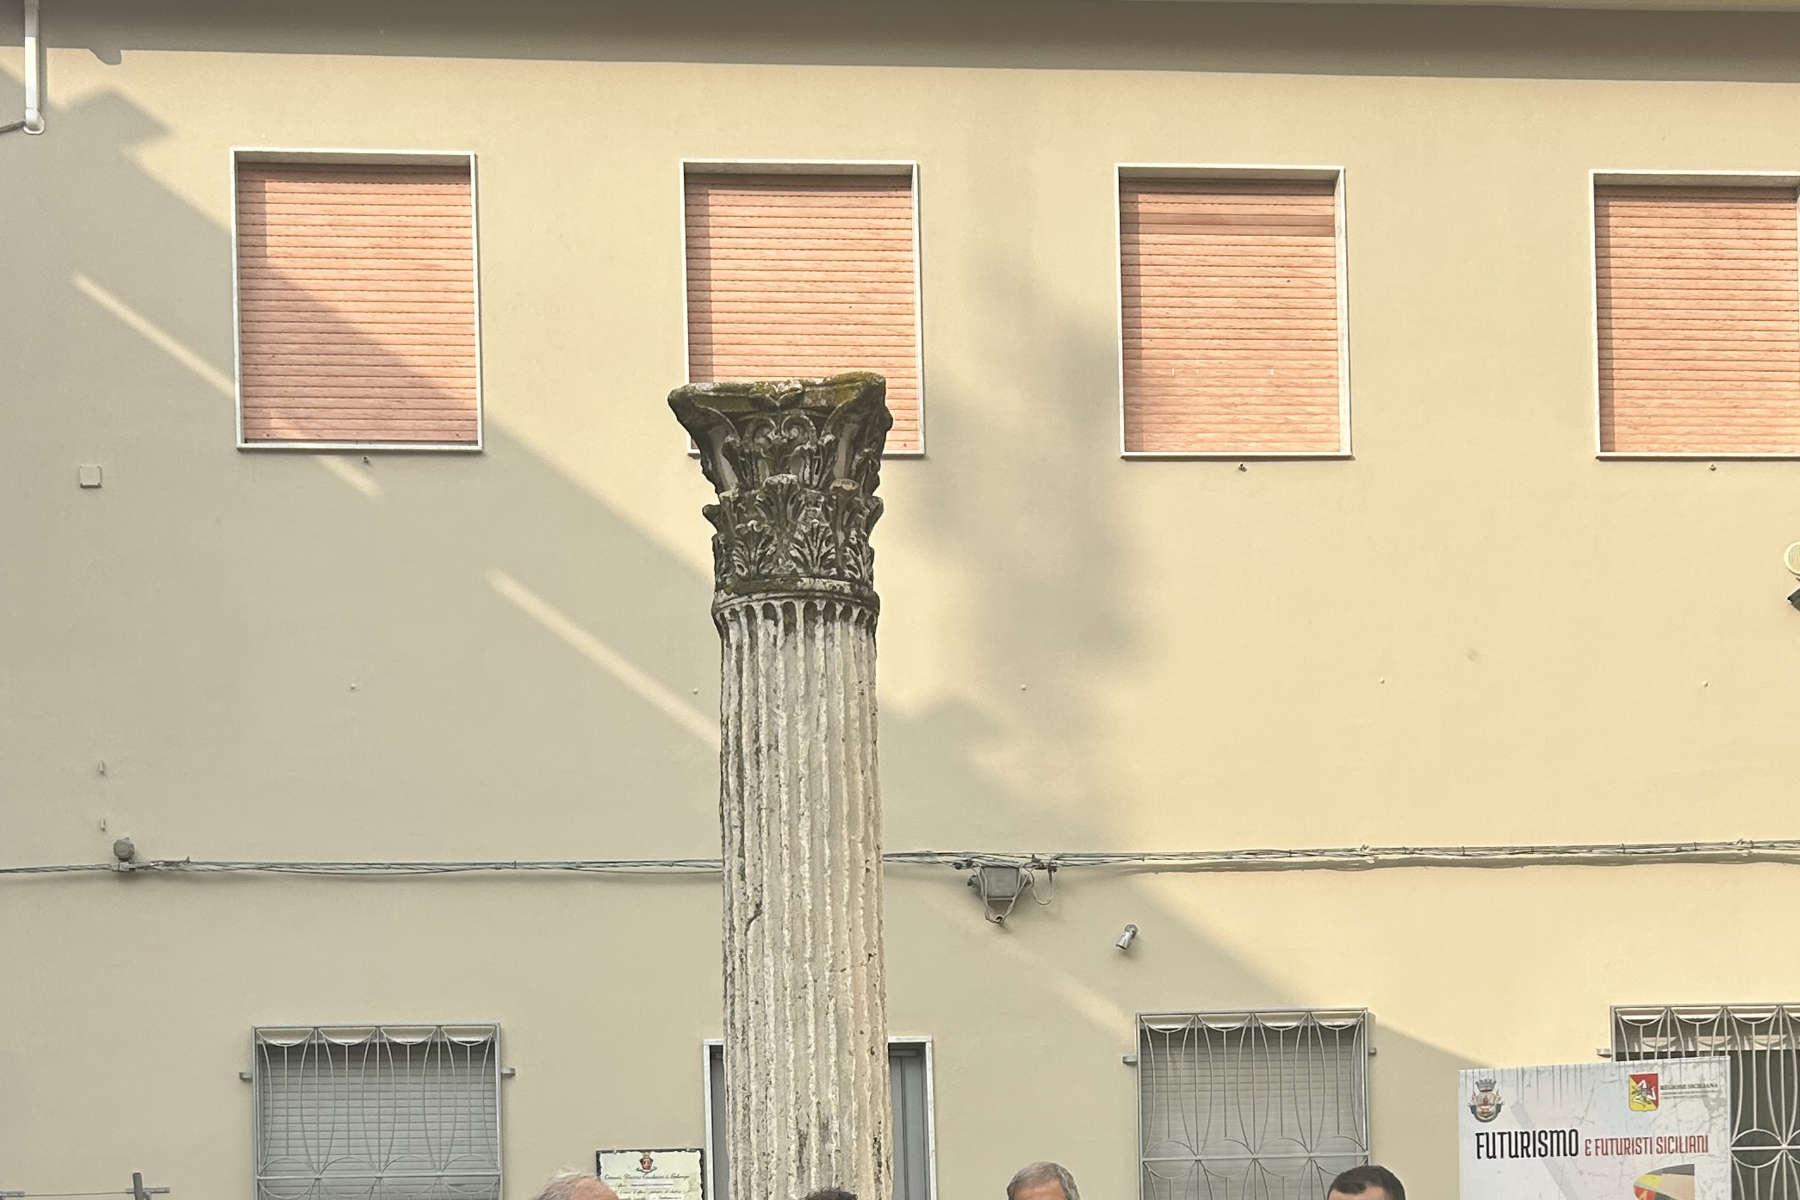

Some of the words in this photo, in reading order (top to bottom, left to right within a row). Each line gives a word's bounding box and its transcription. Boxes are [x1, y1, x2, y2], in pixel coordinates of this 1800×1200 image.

[1475, 1129, 1580, 1160] FUTURISMO
[1595, 1136, 1653, 1157] FUTURISTI
[1656, 1135, 1709, 1155] SICILIANI
